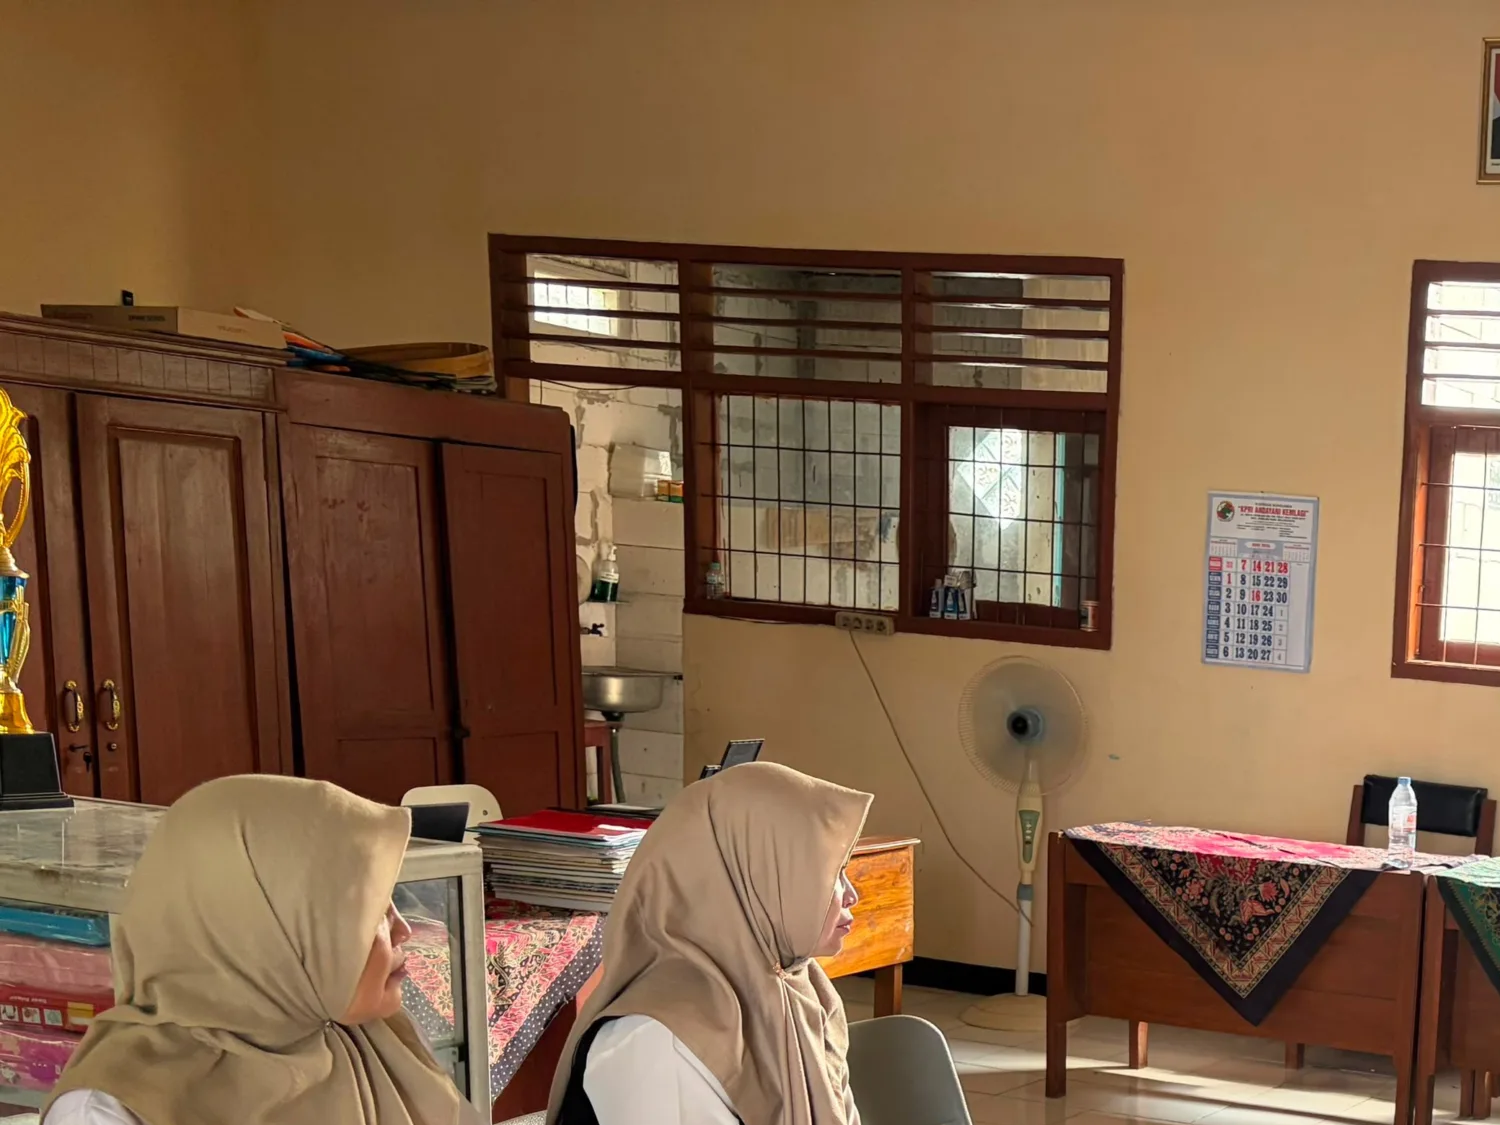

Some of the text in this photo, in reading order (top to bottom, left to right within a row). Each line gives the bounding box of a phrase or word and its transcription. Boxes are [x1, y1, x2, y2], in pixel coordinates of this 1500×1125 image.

[1241, 560, 1246, 570] 7
[1253, 561, 1261, 571] 14
[1265, 562, 1274, 572] 21
[1278, 562, 1288, 573] 28
[1228, 573, 1288, 588] 1 8 15 22 29
[1226, 588, 1287, 603] 2 9 16 23 30
[1225, 603, 1231, 613] 3
[1237, 604, 1246, 615] 10
[1251, 605, 1260, 615] 17
[1263, 606, 1273, 616] 24
[1224, 617, 1230, 628] 4
[1237, 618, 1245, 629] 11
[1250, 620, 1259, 630] 18
[1262, 621, 1272, 631] 25
[1224, 632, 1229, 642] 5
[1236, 633, 1245, 644] 12
[1249, 634, 1258, 645] 19
[1262, 635, 1272, 646] 26
[1223, 646, 1229, 657] 6
[1235, 648, 1244, 658] 13
[1248, 649, 1258, 660] 20
[1261, 650, 1271, 660] 27
